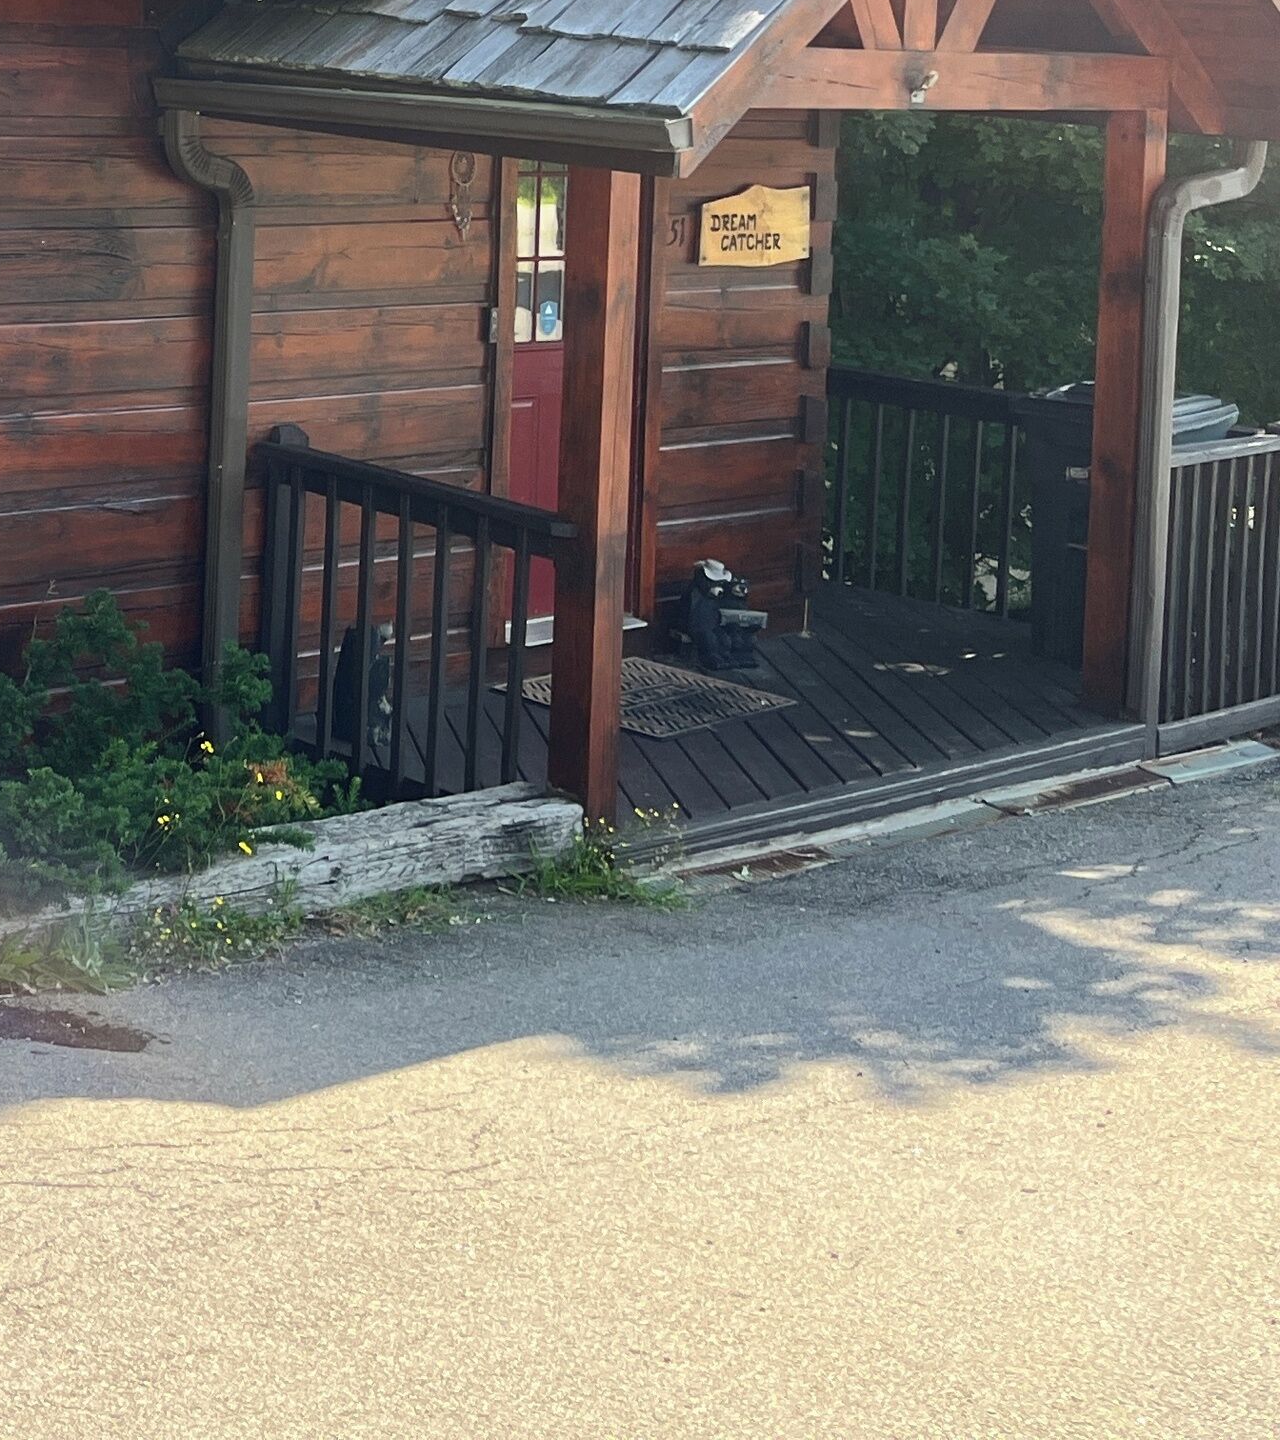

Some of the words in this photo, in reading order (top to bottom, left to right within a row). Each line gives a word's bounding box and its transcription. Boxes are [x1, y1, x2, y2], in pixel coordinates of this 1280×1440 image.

[666, 217, 686, 247] 51
[710, 213, 757, 232] DREAM
[720, 233, 781, 251] CATCHER
